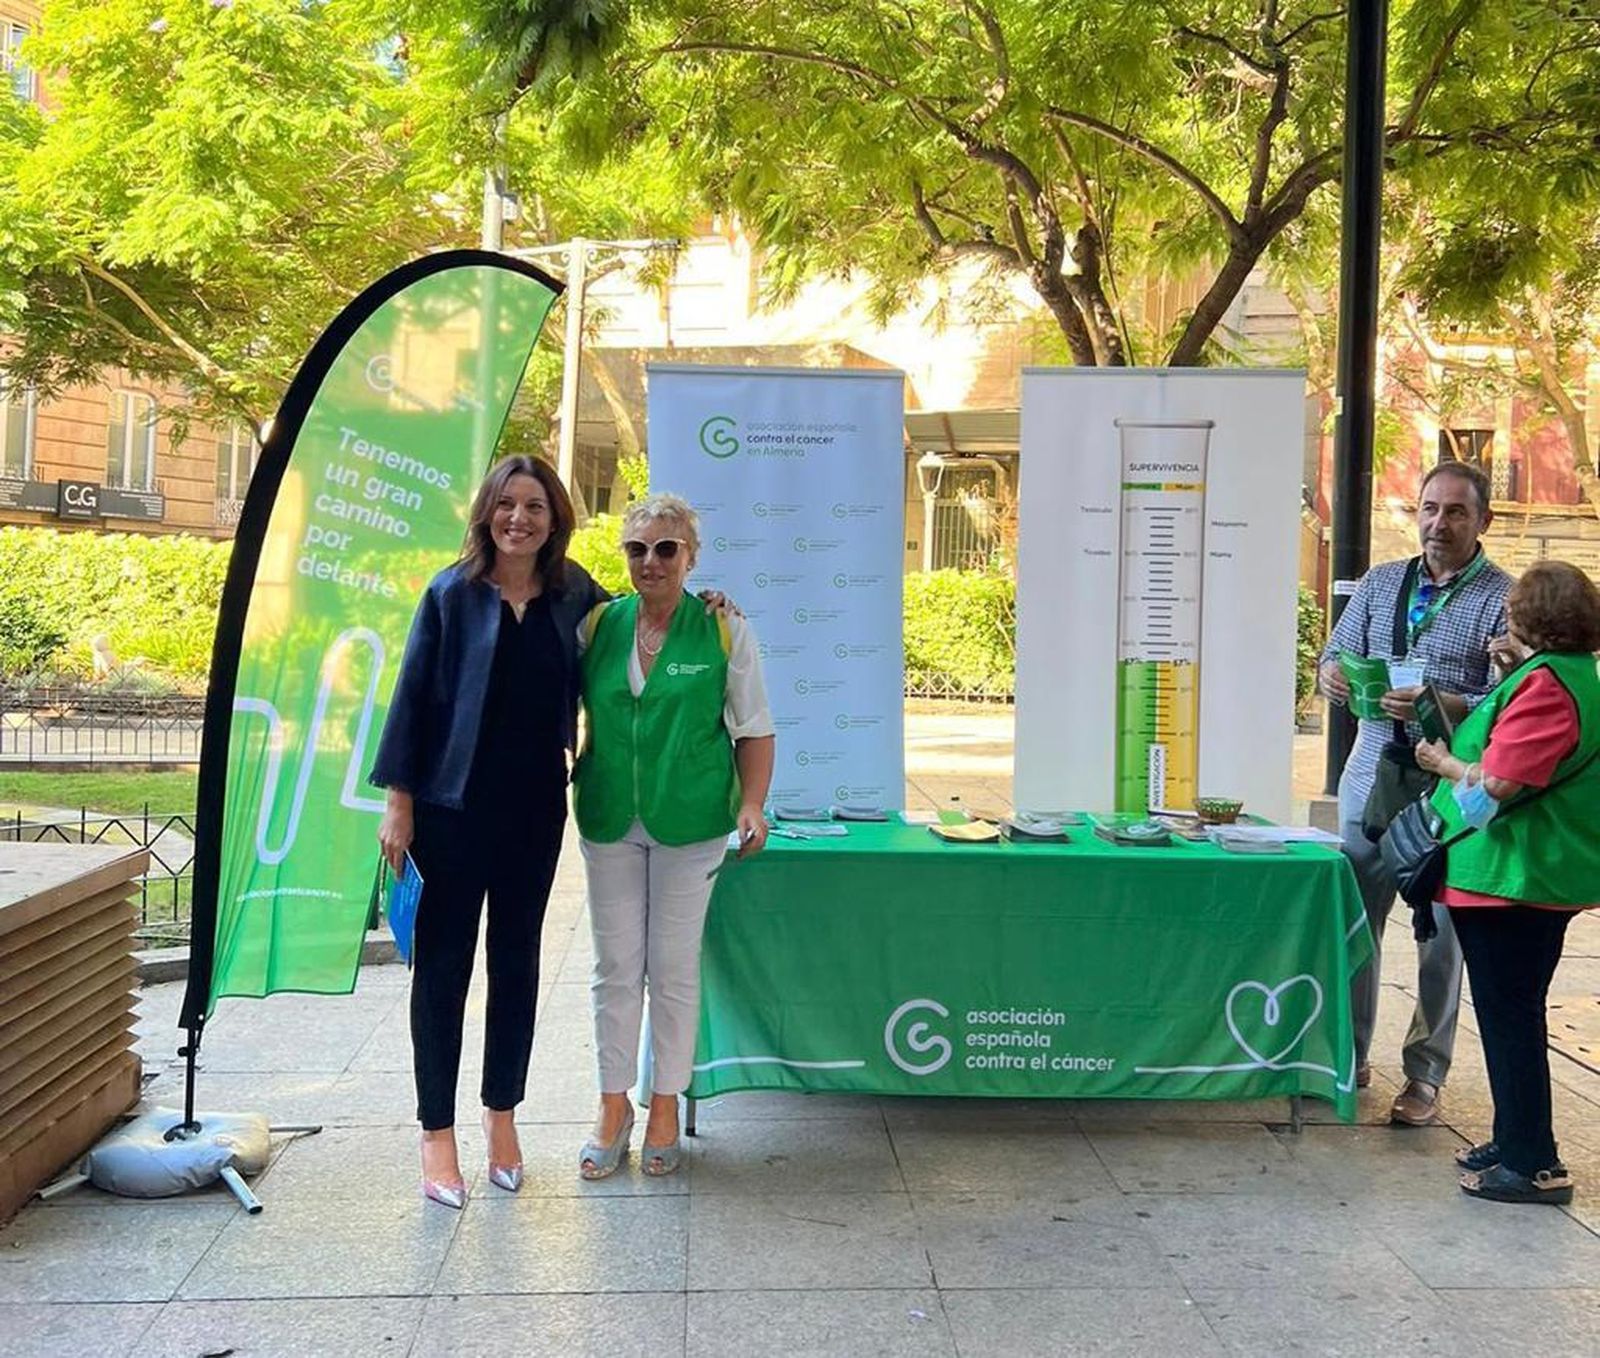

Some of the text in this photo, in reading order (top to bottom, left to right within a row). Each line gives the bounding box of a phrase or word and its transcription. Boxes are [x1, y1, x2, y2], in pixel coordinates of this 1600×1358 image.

[747, 434, 783, 444] contra
[785, 435, 795, 444] el
[338, 426, 453, 490] Tenemos
[747, 448, 761, 456] en
[1129, 462, 1200, 472] SUPERVIVENCIA
[325, 462, 424, 511] un gran
[314, 493, 411, 538] camino
[303, 523, 353, 552] por
[297, 553, 398, 599] delante
[966, 1007, 1065, 1026] asociación
[965, 1030, 1051, 1051] española
[965, 1053, 1116, 1072] contra el cáncer
